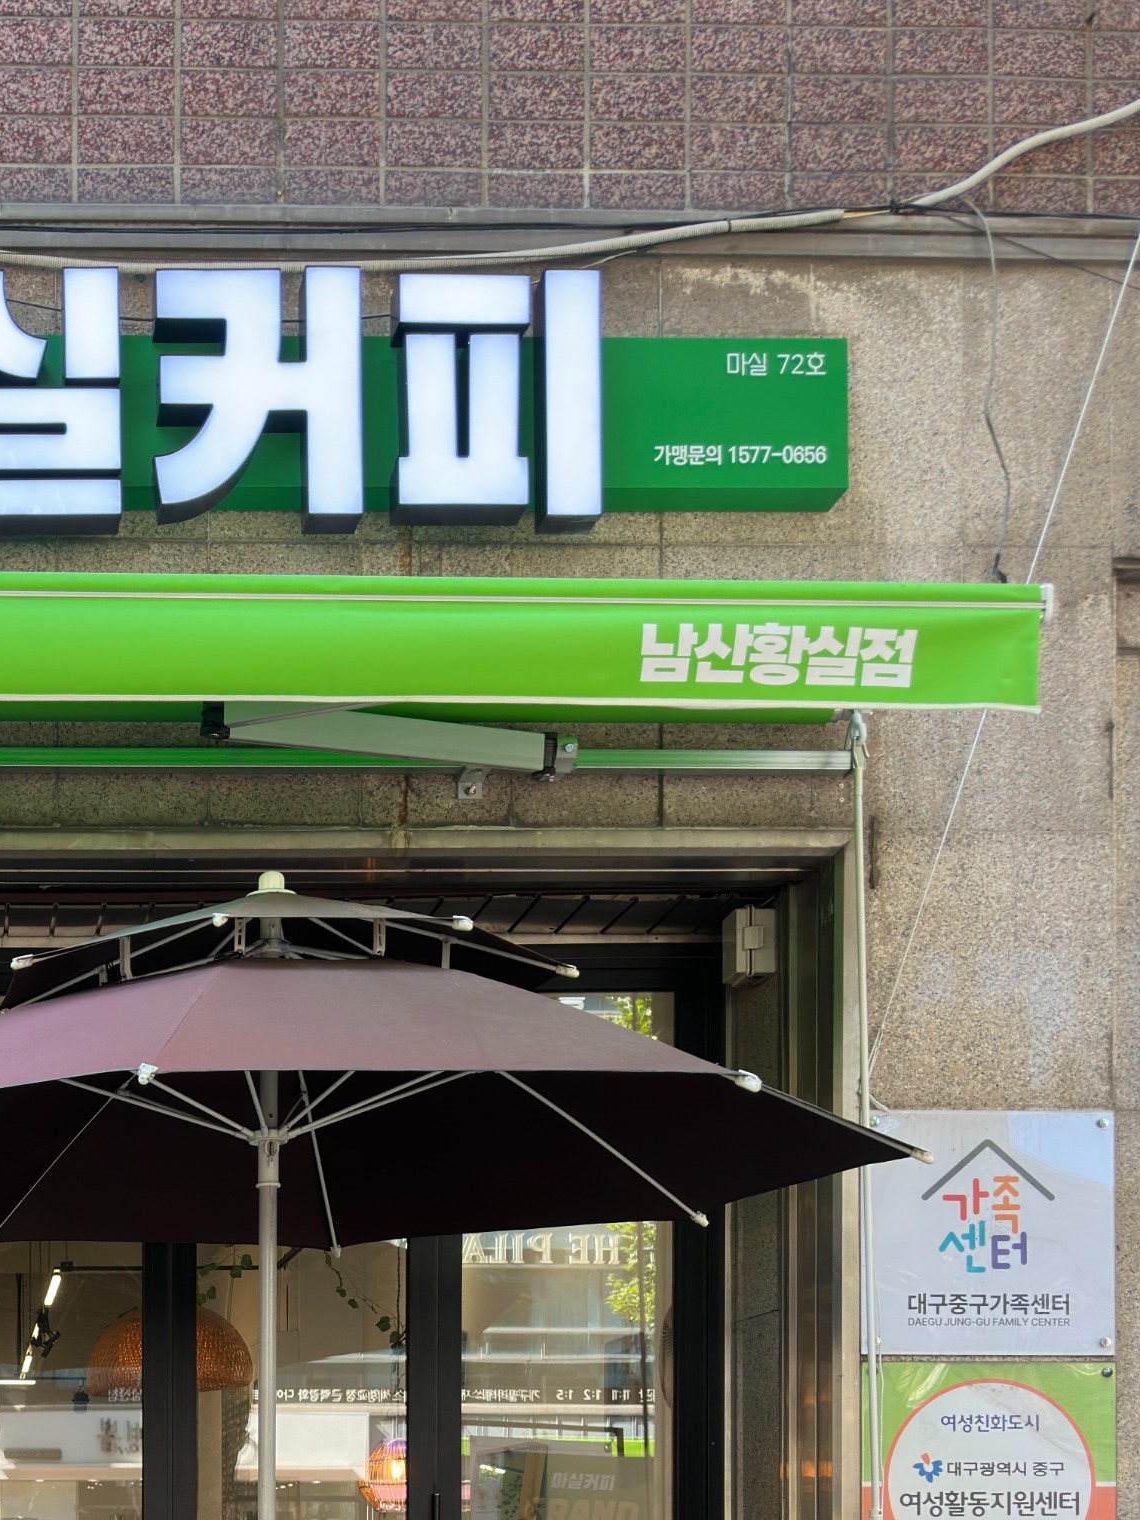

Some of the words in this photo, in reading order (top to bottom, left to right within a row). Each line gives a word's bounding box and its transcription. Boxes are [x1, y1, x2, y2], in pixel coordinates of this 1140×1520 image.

[726, 352, 768, 377] 마실
[776, 351, 827, 376] 72호
[653, 444, 723, 466] 가맹문의
[727, 445, 827, 464] 1577-0656
[638, 621, 920, 690] 남산황실점
[942, 1175, 1022, 1235] 가족
[938, 1219, 1028, 1274] 센터
[907, 1292, 1071, 1316] 대구중구가족센터
[907, 1317, 943, 1328] DAEGU
[944, 1317, 991, 1328] JUNG-GU
[992, 1317, 1029, 1328] FAMILY
[1031, 1317, 1071, 1328] CENTER
[940, 1413, 1041, 1433] 여성친화도시
[946, 1461, 1028, 1477] 대구광역시
[1032, 1461, 1065, 1477] 중구
[550, 1472, 616, 1491] 마실커피
[899, 1490, 1081, 1518] 여성활동지원센터
